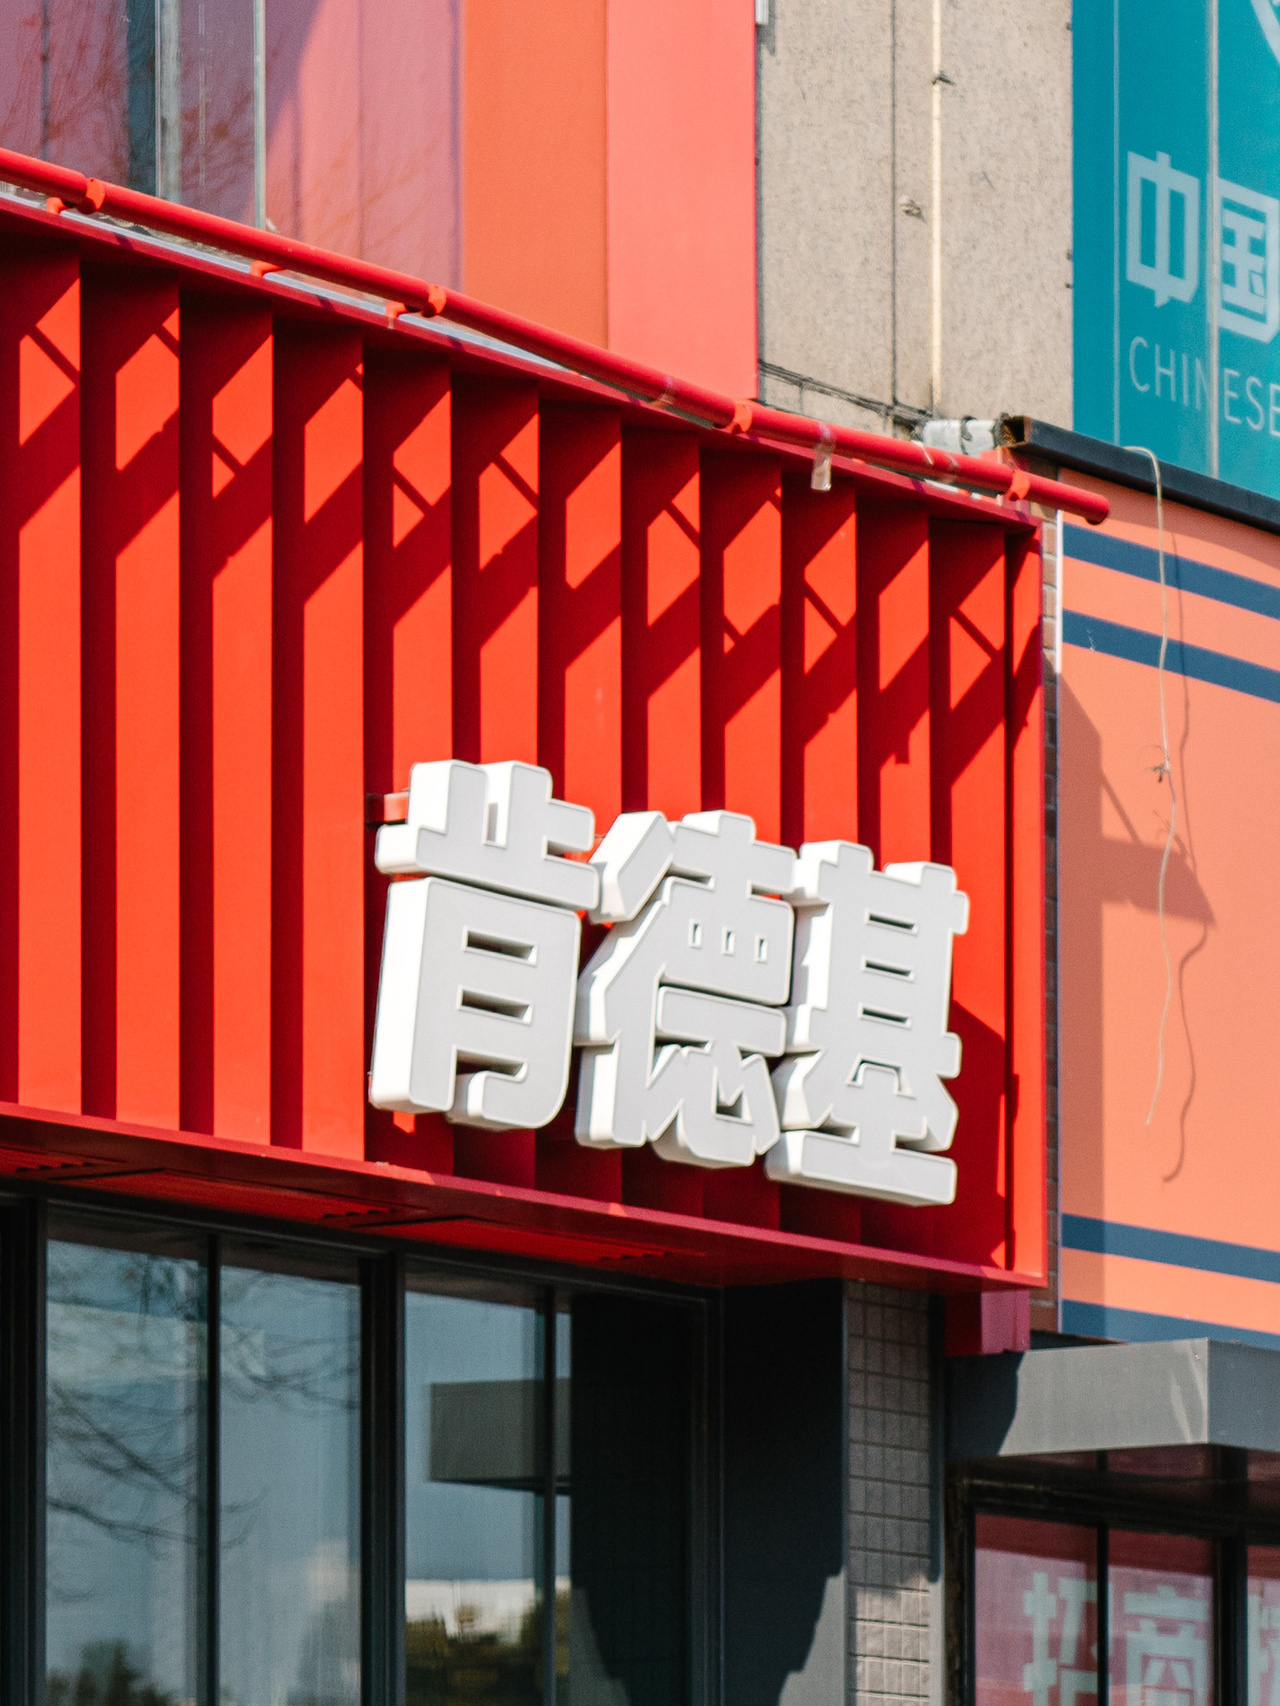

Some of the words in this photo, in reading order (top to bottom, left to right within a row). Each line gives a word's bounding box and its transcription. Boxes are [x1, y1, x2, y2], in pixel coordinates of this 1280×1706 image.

[1126, 150, 1280, 344] 中国
[368, 759, 970, 1206] 肯德基
